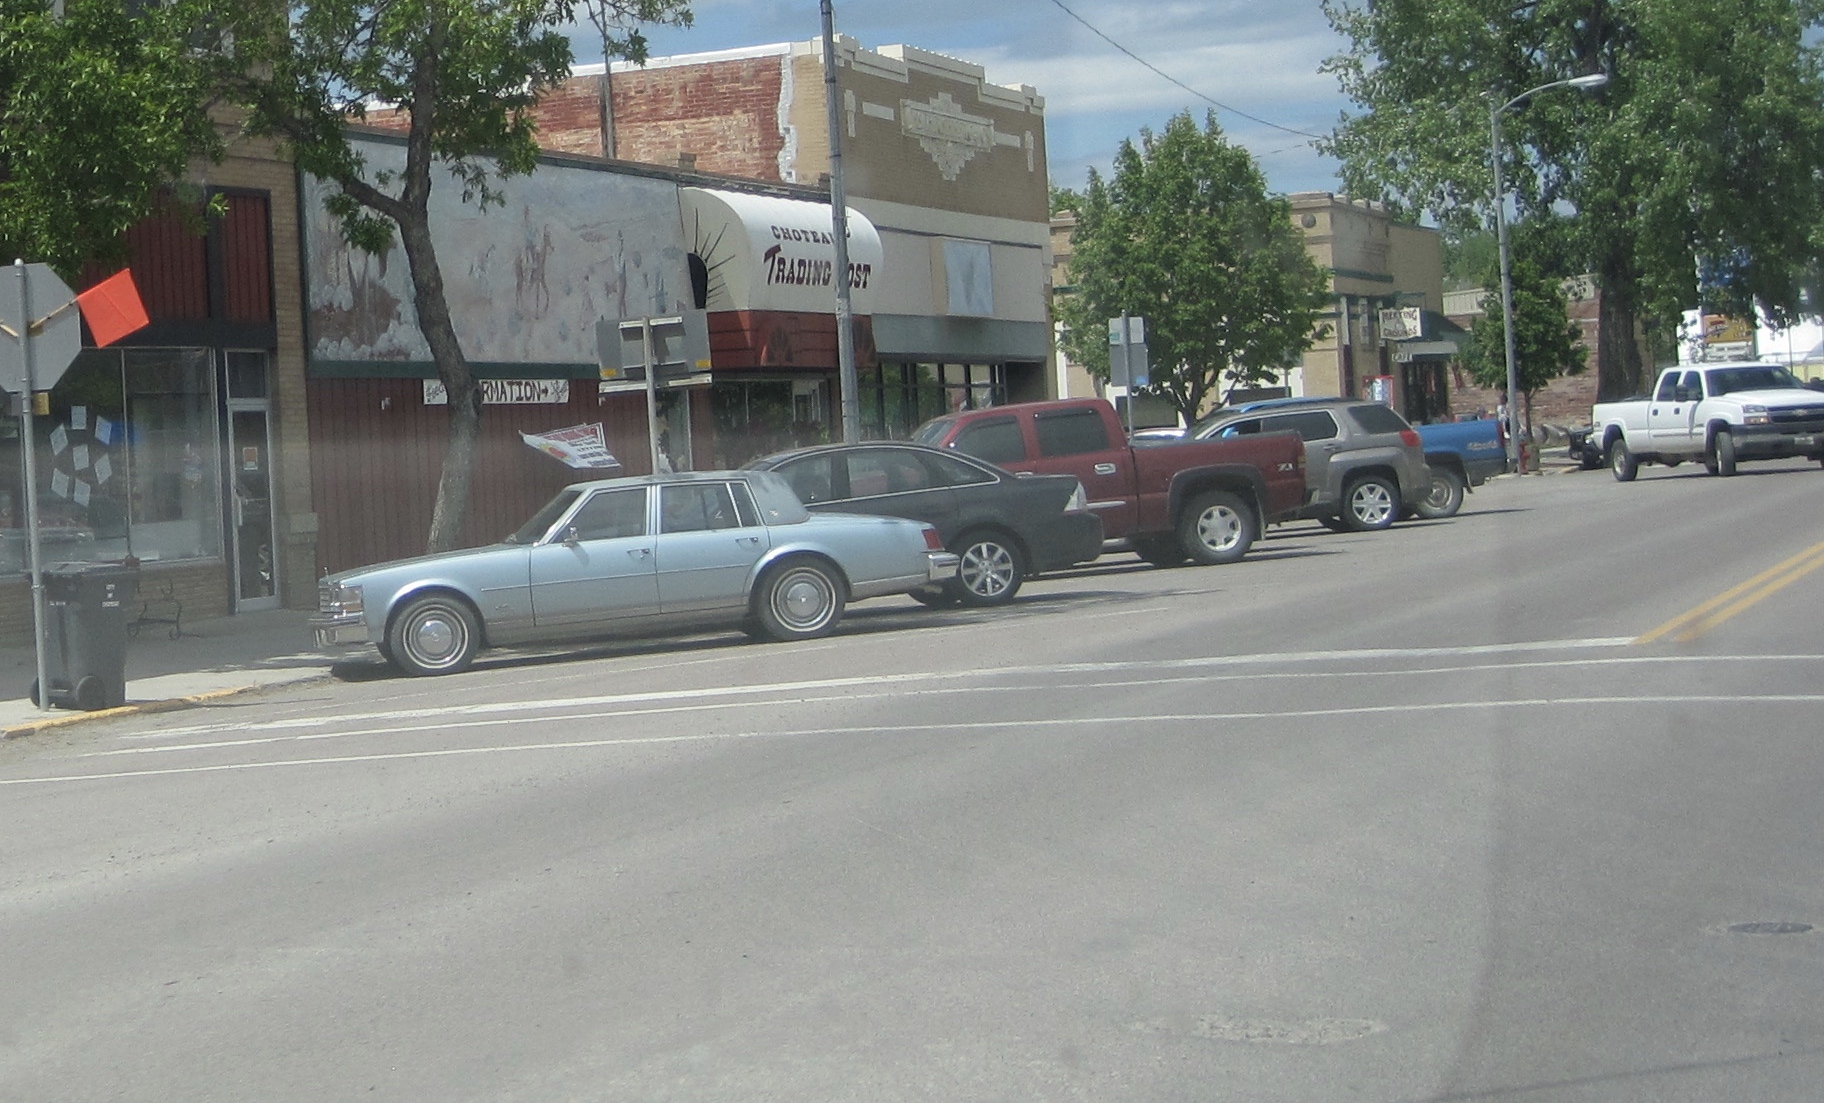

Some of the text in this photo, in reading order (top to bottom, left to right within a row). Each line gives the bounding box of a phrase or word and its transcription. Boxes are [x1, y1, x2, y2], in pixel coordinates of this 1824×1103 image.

[763, 243, 872, 290] TRADING OST
[480, 380, 542, 403] RMATION
